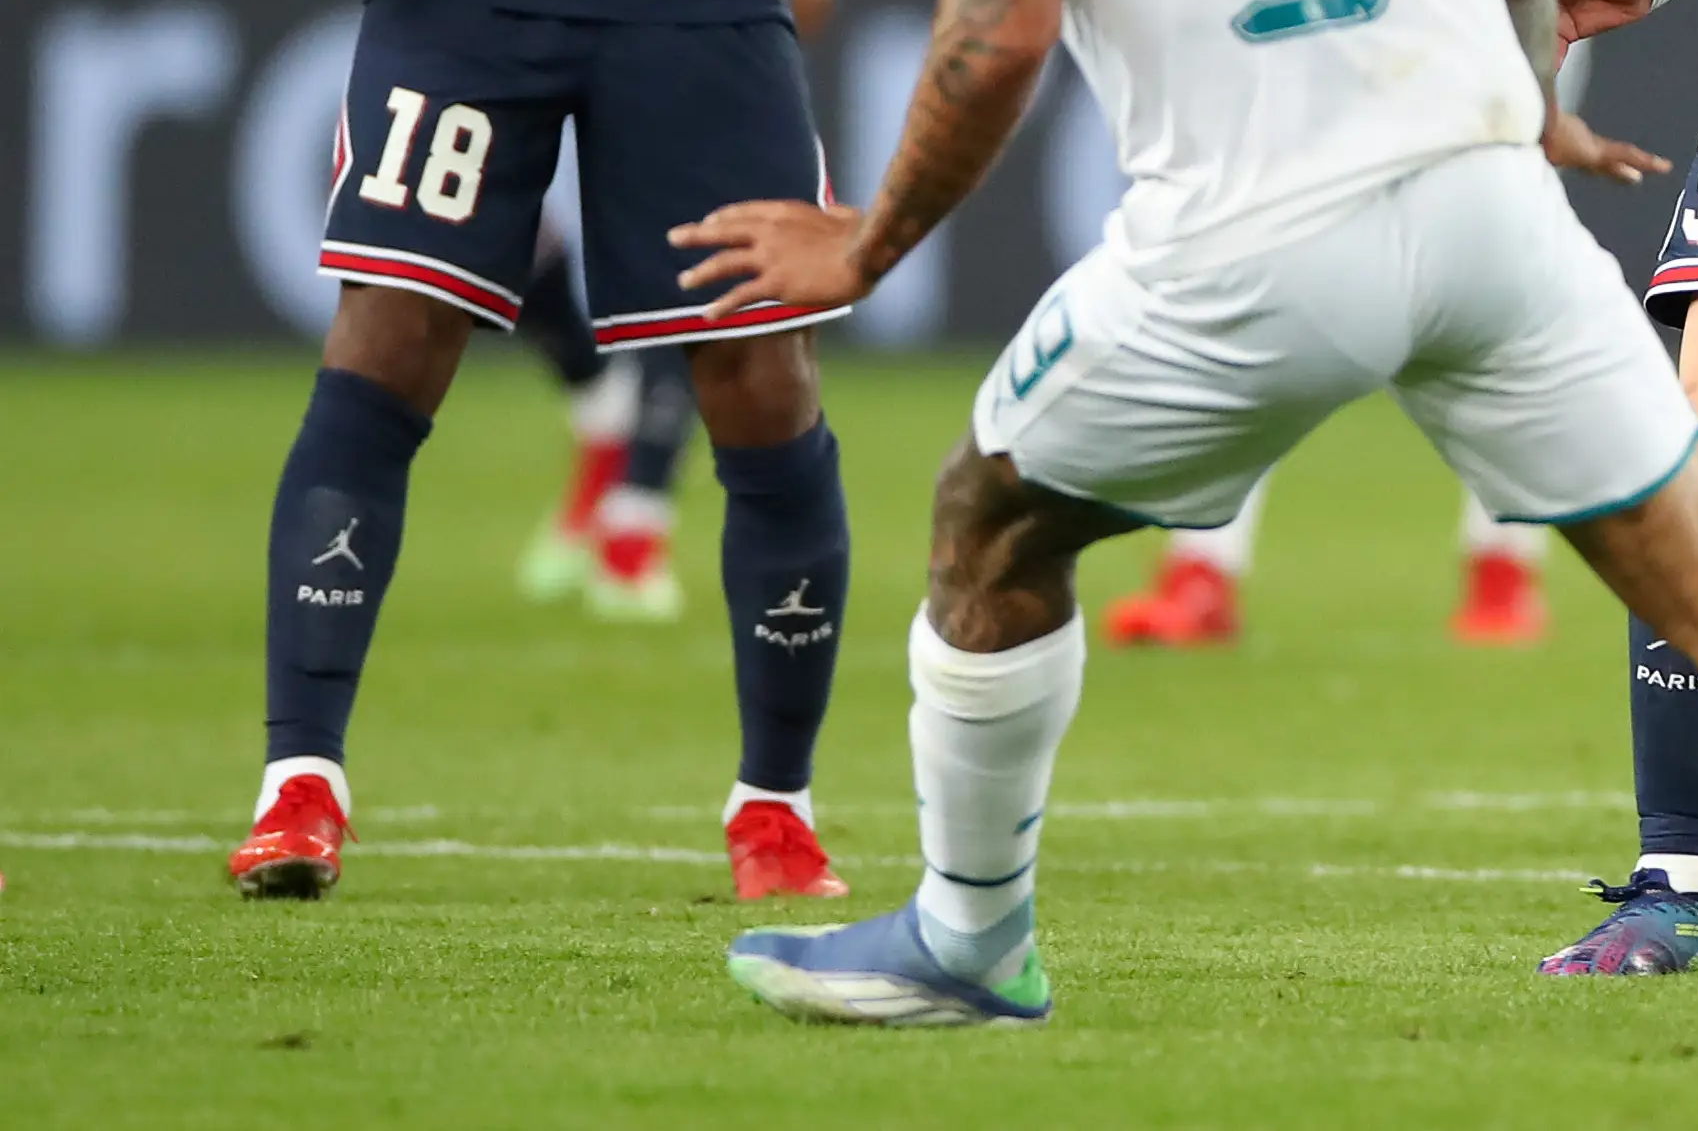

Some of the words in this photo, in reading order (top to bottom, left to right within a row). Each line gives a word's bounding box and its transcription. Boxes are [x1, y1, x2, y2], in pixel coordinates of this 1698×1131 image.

[358, 86, 496, 227] 18
[297, 584, 364, 606] PARIS
[755, 621, 832, 647] PARIS
